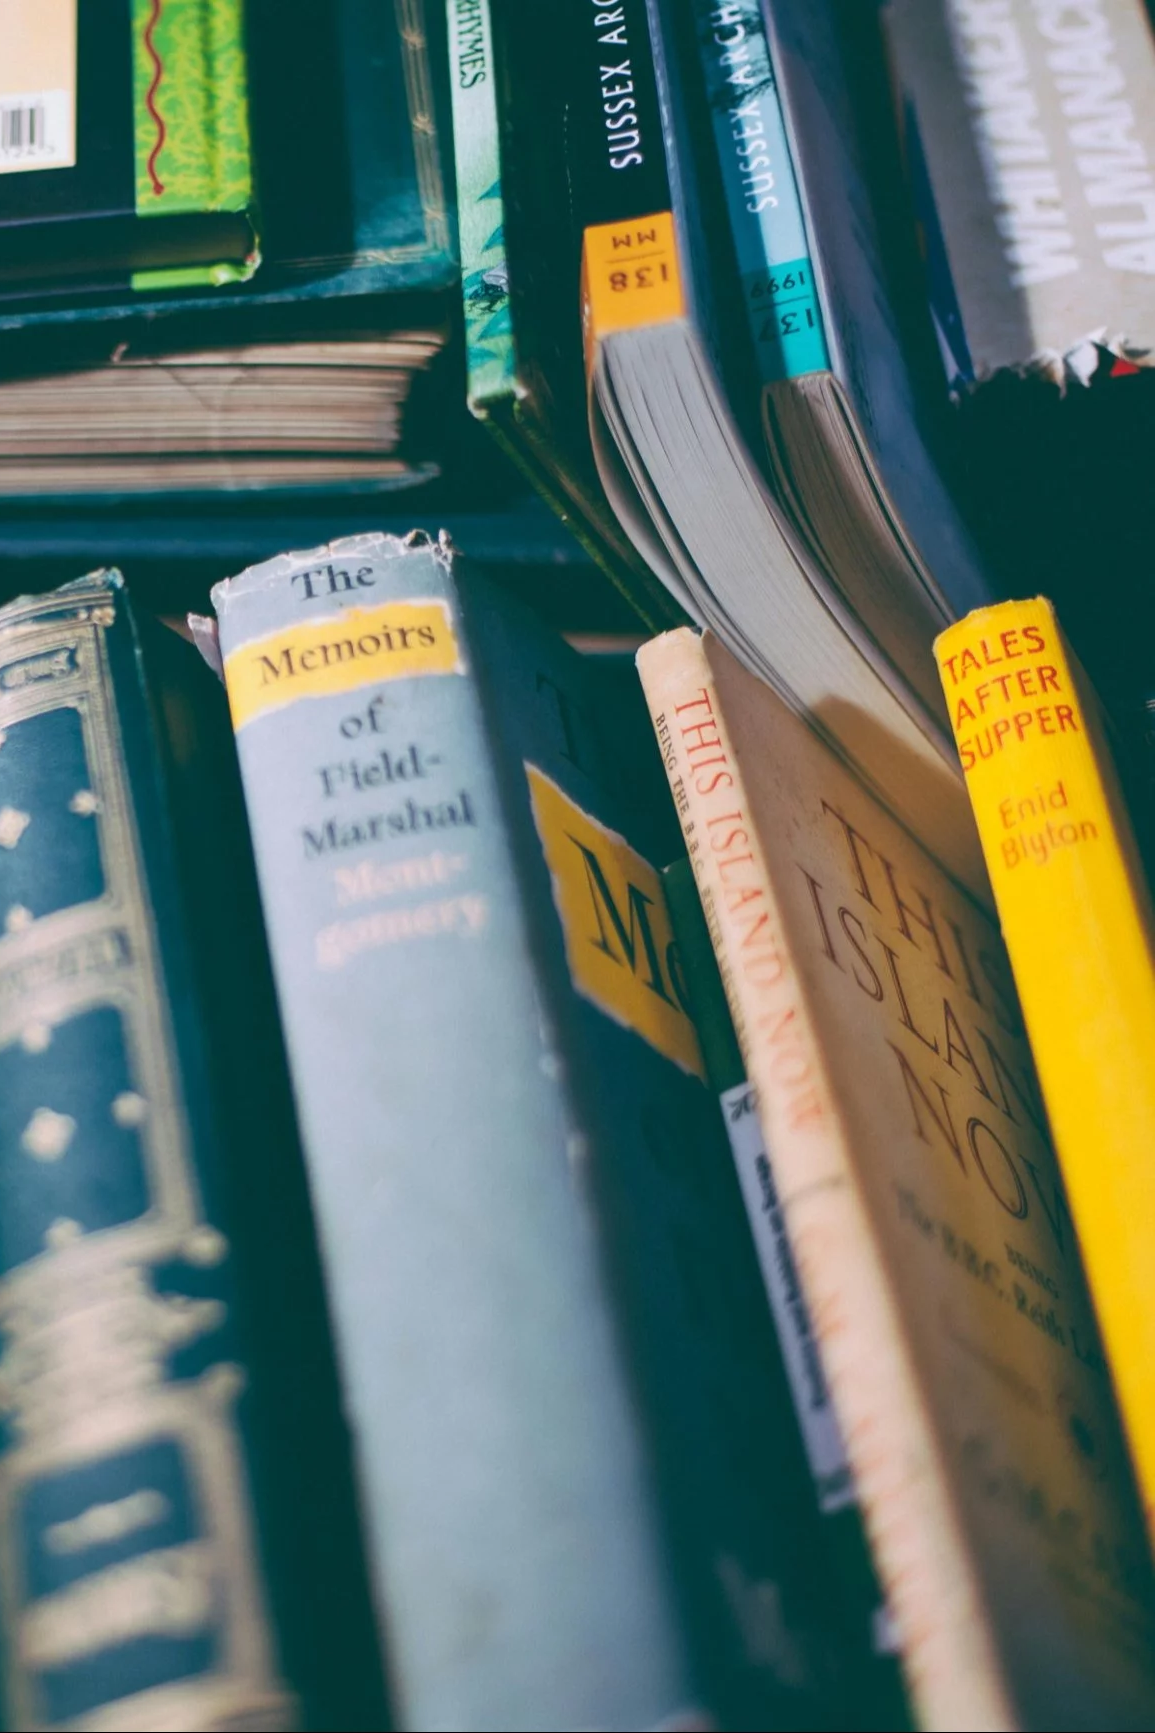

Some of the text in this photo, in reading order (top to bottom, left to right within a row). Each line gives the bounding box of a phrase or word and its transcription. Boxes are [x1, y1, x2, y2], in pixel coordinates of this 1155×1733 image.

[600, 59, 642, 170] SUSSEX
[729, 99, 779, 214] SUSSEX
[611, 229, 656, 250] MM
[608, 263, 670, 293] 138
[750, 271, 806, 299] 1999
[757, 308, 815, 342] 137
[291, 562, 378, 601] The
[255, 621, 437, 688] Memoirs
[941, 625, 1045, 686] TALES
[338, 694, 386, 740] of
[955, 664, 1062, 732] AFTER
[655, 713, 677, 772] BEING
[673, 775, 691, 816] THE
[959, 704, 1079, 773] SUPPER
[318, 743, 443, 799] Field-
[300, 792, 479, 860] Marshal
[998, 779, 1069, 831] Enid
[674, 687, 733, 797] THIS
[705, 809, 789, 990] ISLAND
[1000, 818, 1100, 872] Blyton
